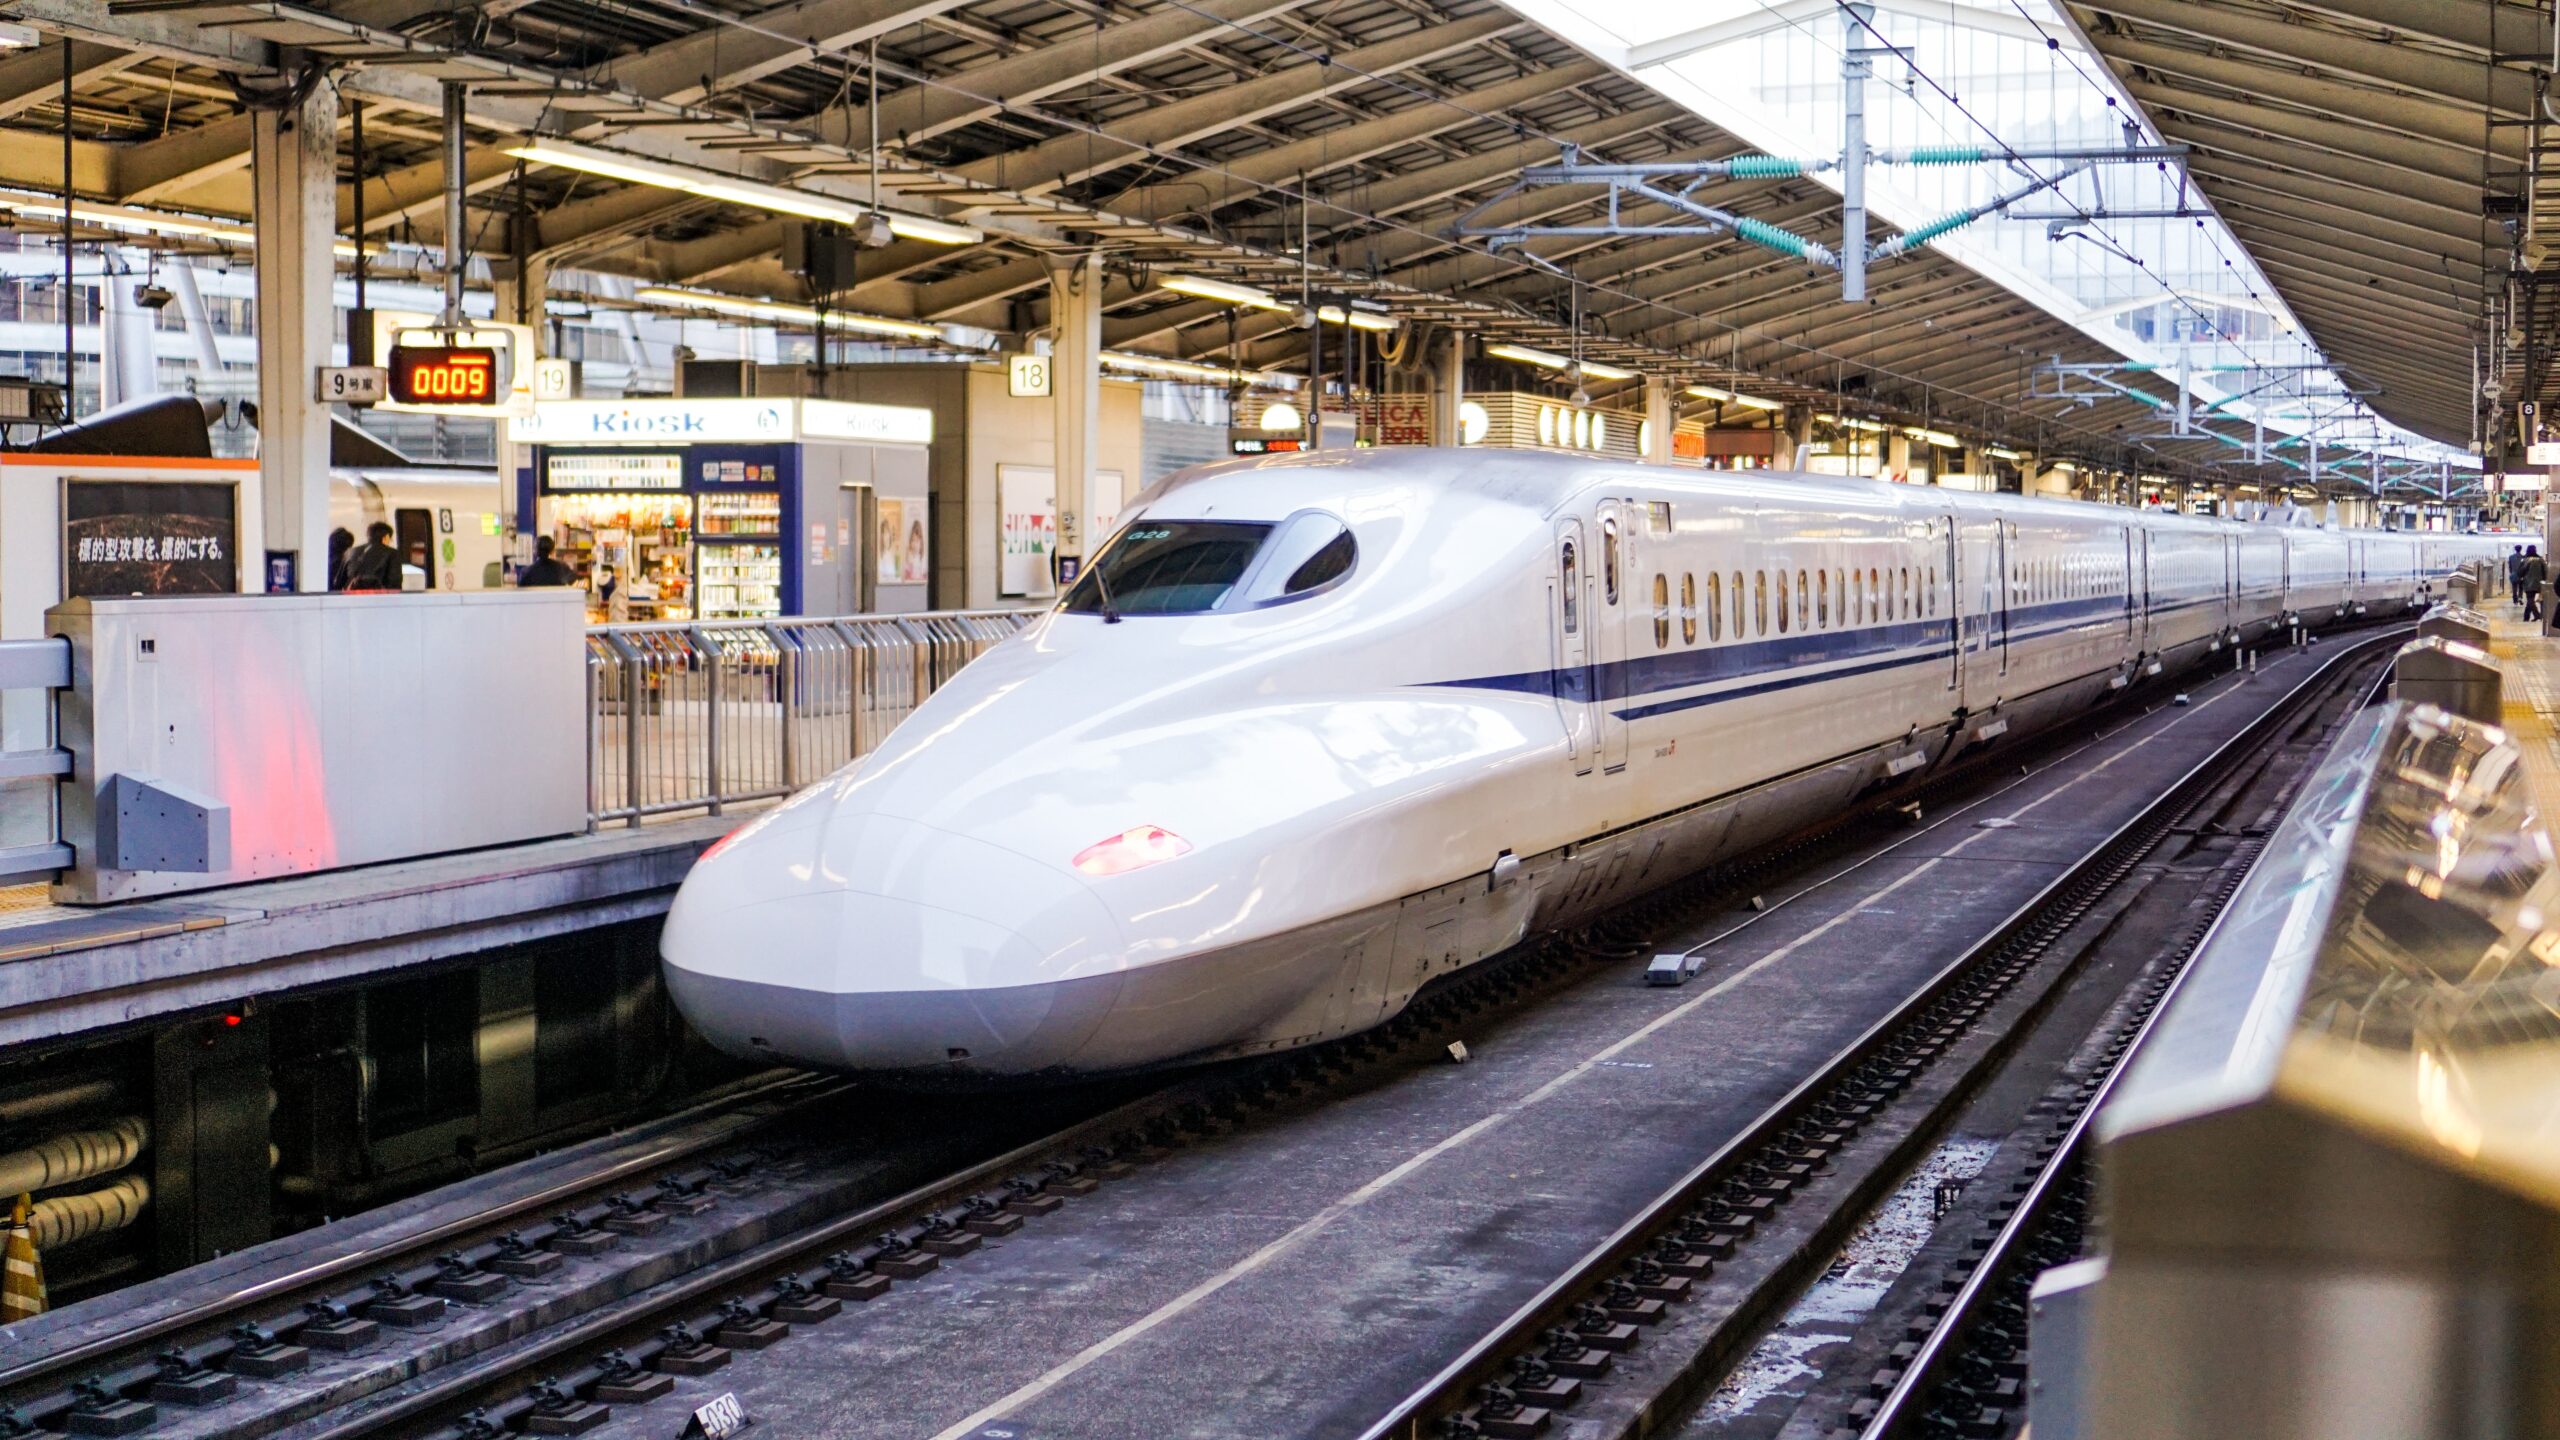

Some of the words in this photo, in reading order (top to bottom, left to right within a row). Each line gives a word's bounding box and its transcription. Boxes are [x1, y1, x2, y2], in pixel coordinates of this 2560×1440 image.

[414, 367, 485, 395] 0009
[542, 369, 564, 392] 19
[1019, 364, 1042, 388] 18
[1310, 414, 1317, 423] 8
[2525, 404, 2533, 414] 8
[592, 410, 704, 433] Kiosk
[441, 510, 450, 531] 8
